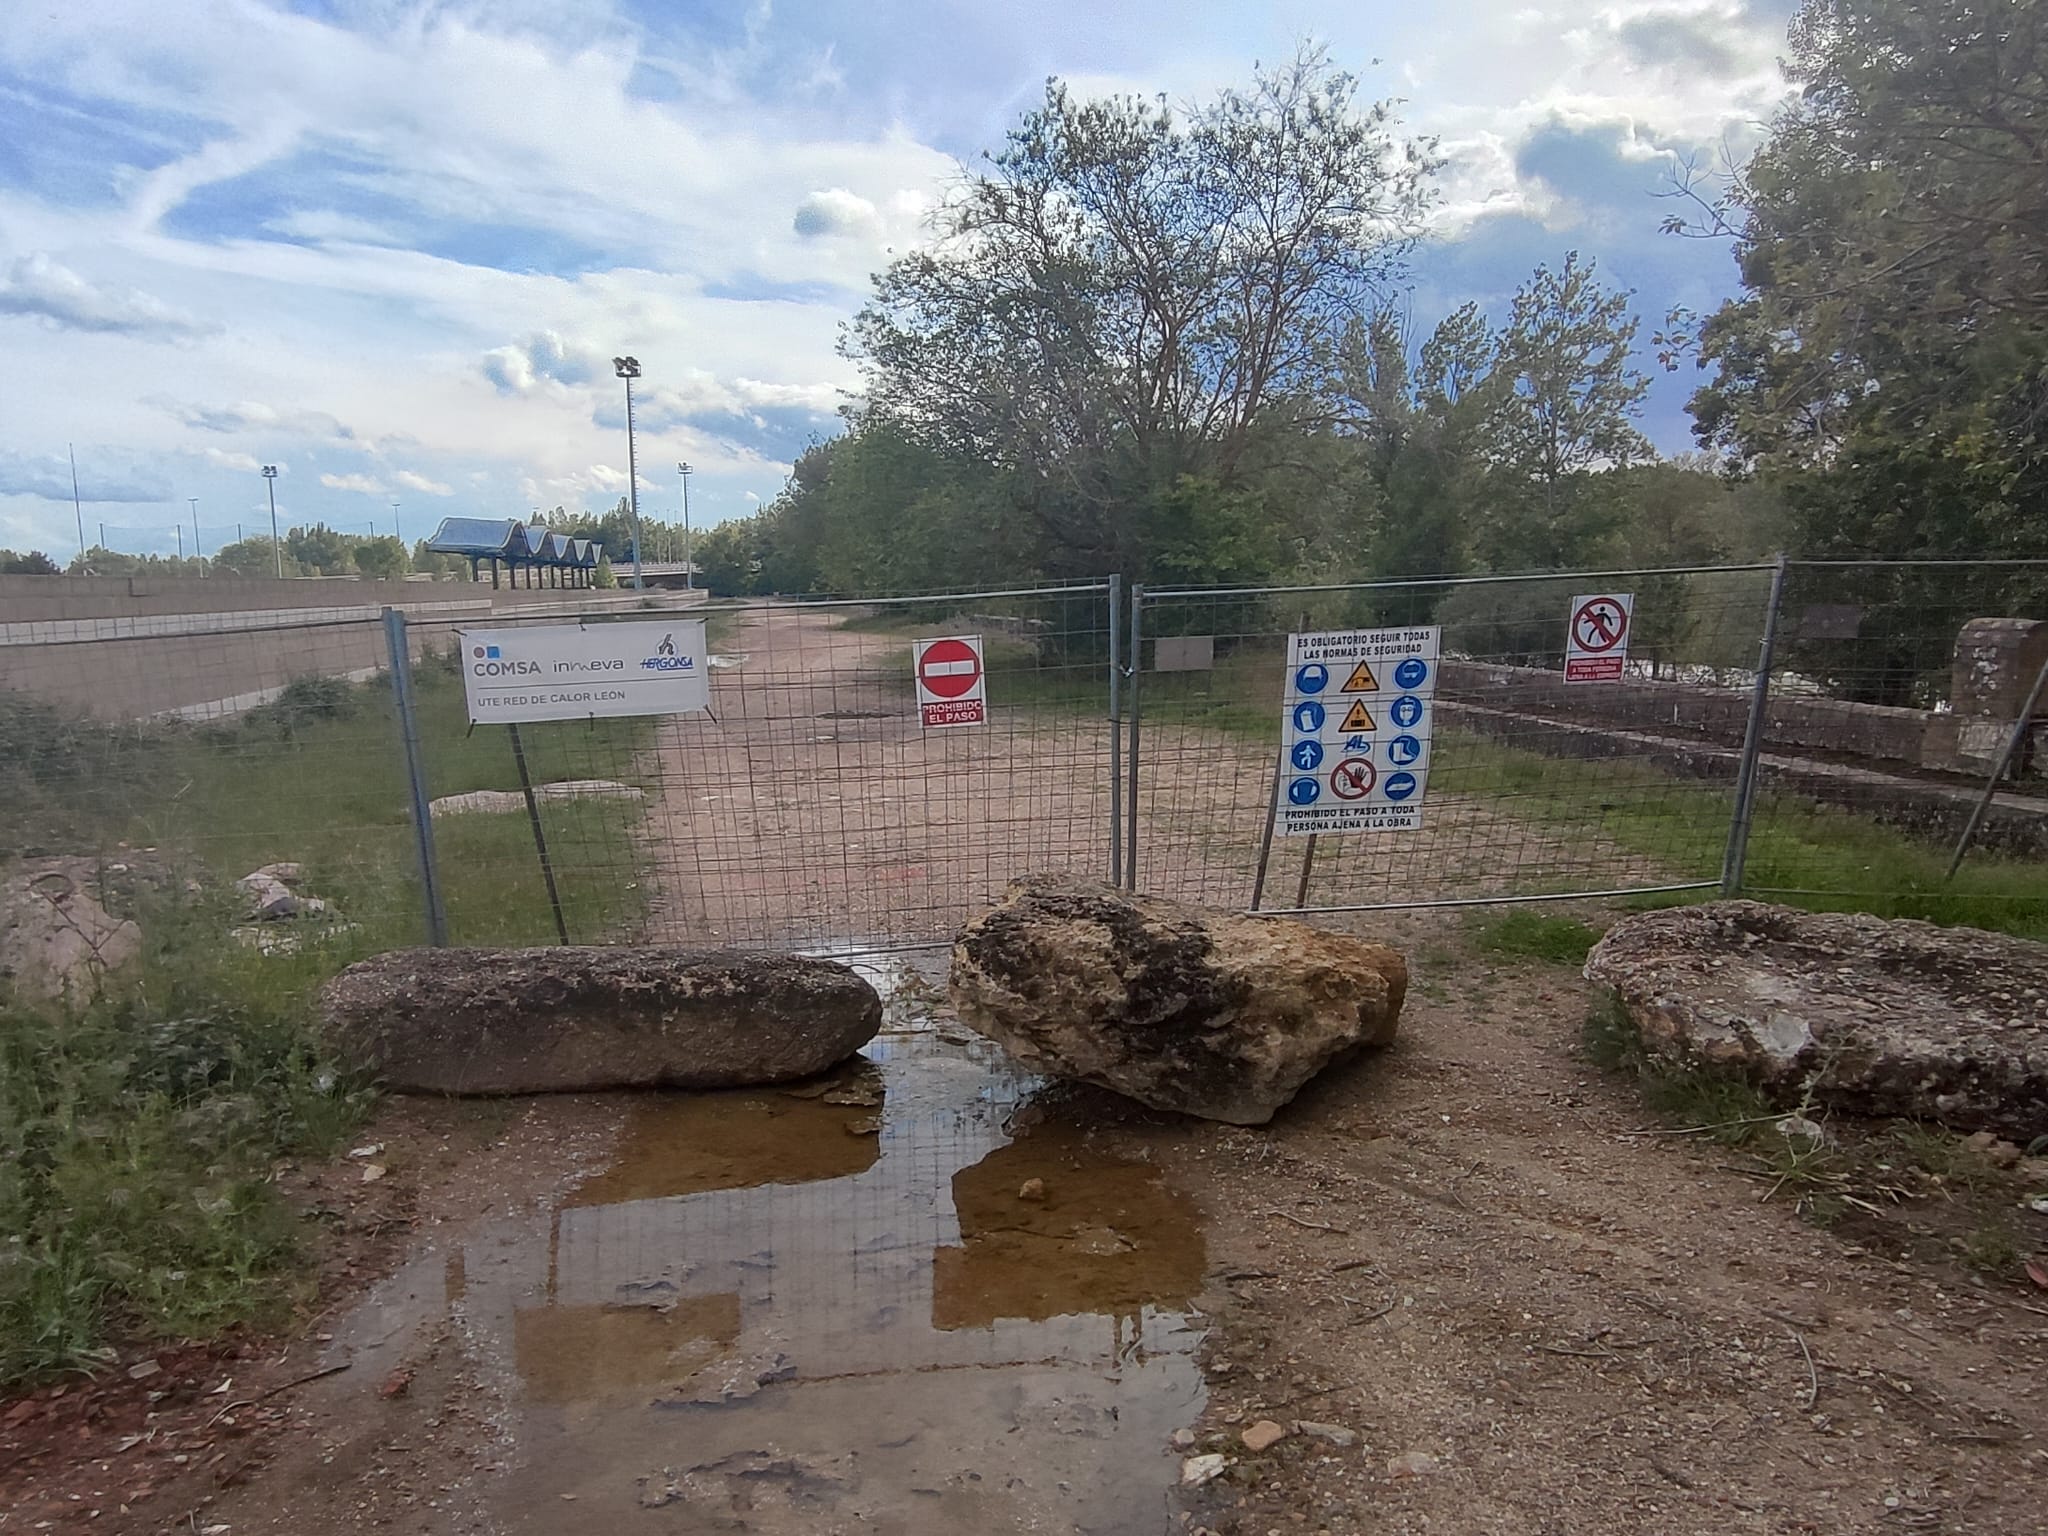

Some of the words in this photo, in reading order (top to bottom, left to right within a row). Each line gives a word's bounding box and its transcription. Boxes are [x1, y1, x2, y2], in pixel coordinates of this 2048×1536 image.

[1297, 638, 1308, 648] ES
[1311, 634, 1367, 647] OBLIGATORIO
[1369, 632, 1400, 644] SEGUIR
[1403, 631, 1430, 642] TODAS
[1304, 649, 1320, 660] LAS
[1322, 646, 1358, 658] NORMAS
[1361, 646, 1372, 656] DE
[1374, 644, 1422, 655] SEGURIDAD
[474, 661, 542, 677] COMSA
[640, 656, 694, 671] HERGONSA
[478, 697, 500, 707] UTE
[503, 696, 528, 706] RED
[531, 695, 547, 704] DE
[550, 692, 591, 703] CALOR
[929, 714, 944, 723] EL
[946, 711, 977, 722] PASO
[1285, 809, 1337, 820] PROHIBIDO
[1339, 808, 1351, 817] EL
[1354, 807, 1378, 817] PASO
[1380, 807, 1388, 815] A
[1391, 805, 1415, 815] TODA
[1287, 821, 1329, 832] PERSONA
[1331, 820, 1361, 830] AJENA
[1363, 819, 1370, 828] A
[1372, 818, 1384, 827] LA
[1386, 817, 1412, 827] OBRA
